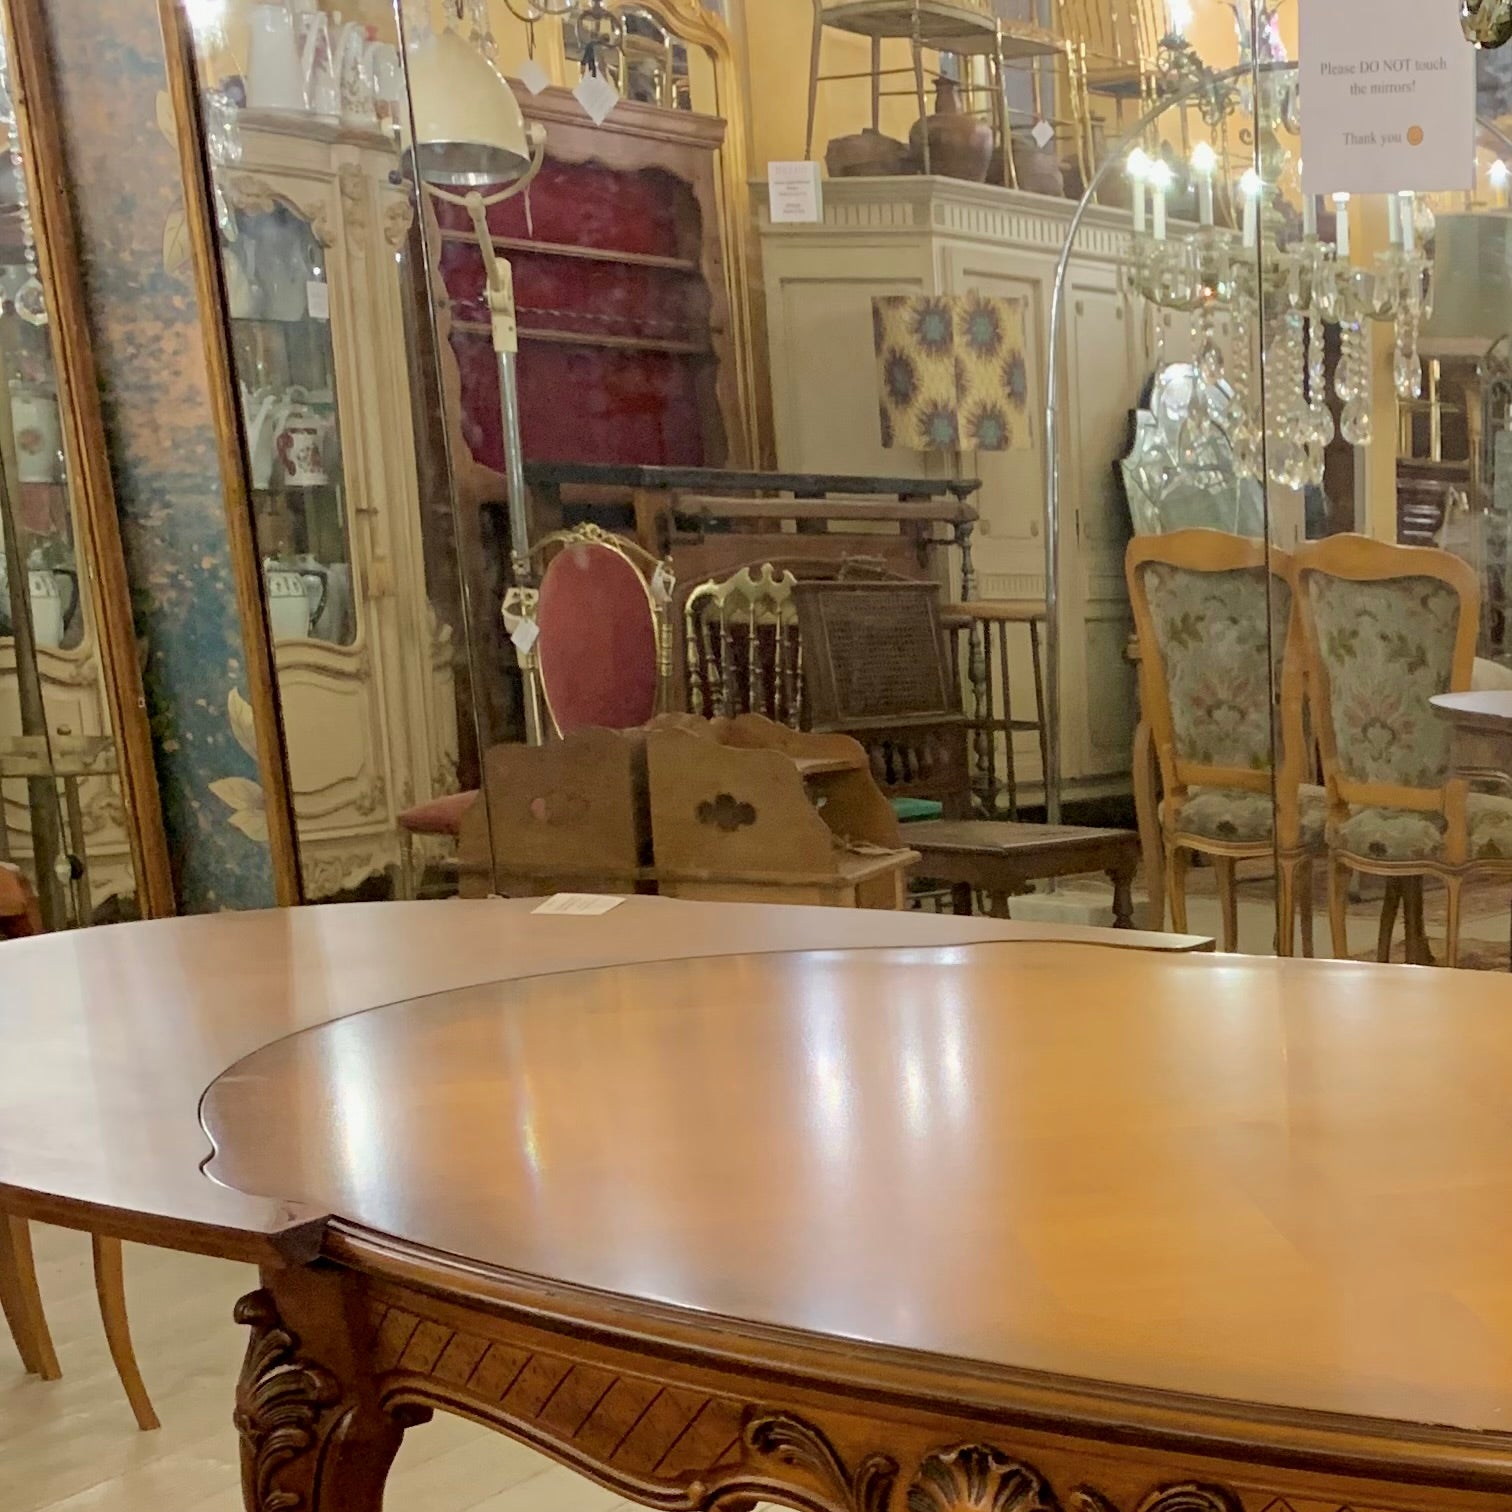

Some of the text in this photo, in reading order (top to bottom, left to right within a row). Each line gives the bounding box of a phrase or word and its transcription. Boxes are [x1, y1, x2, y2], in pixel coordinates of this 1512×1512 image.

[1320, 57, 1447, 76] Please DO NOT touch
[1350, 80, 1416, 96] the mirrors!
[1342, 132, 1402, 147] Thank you
